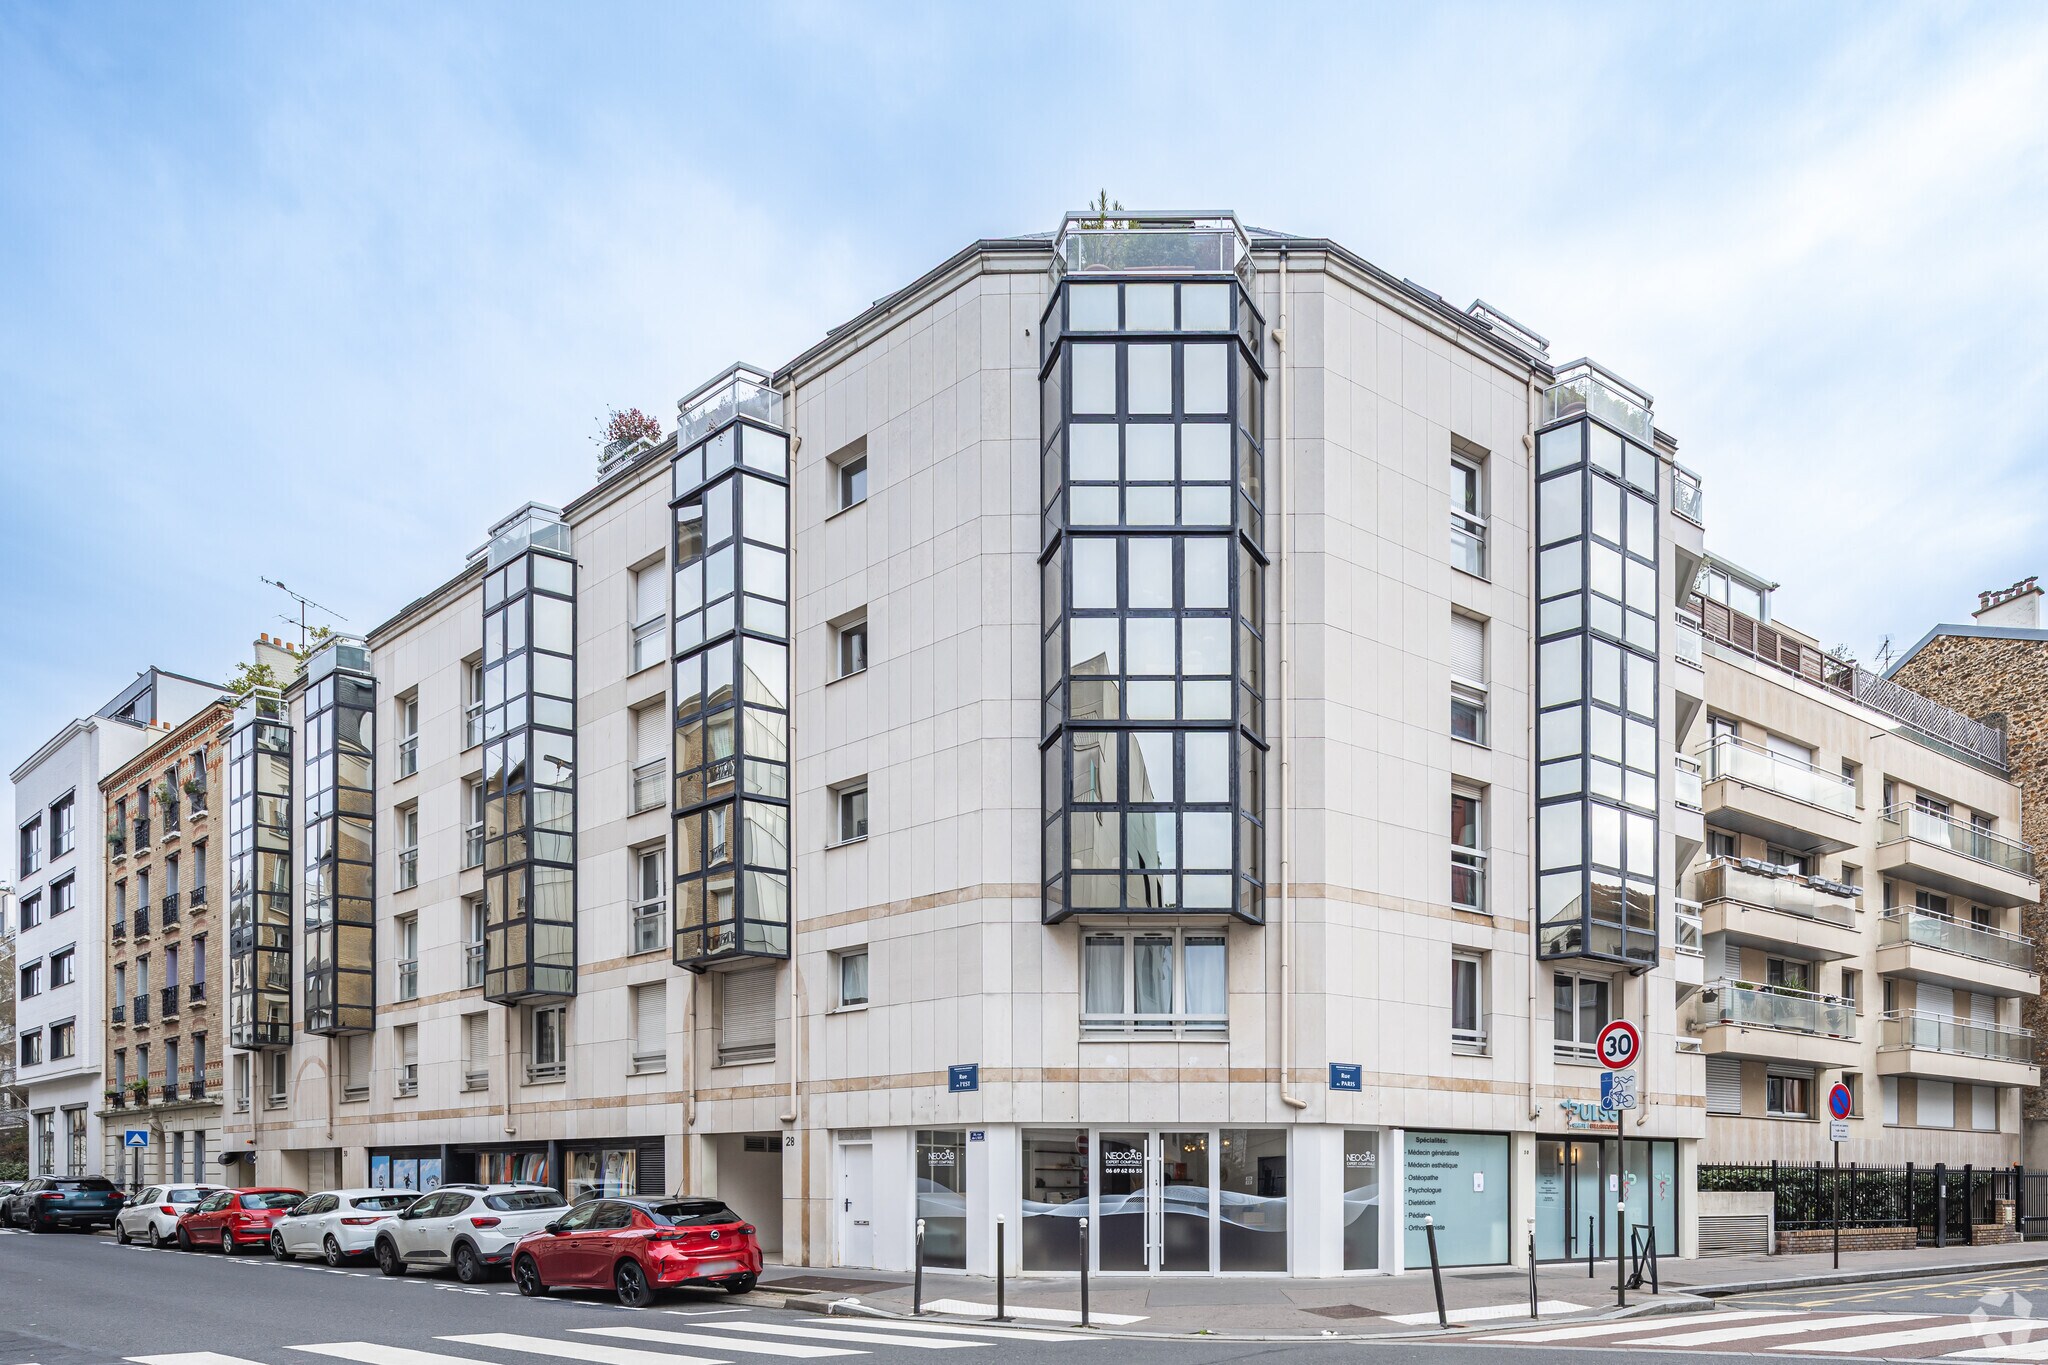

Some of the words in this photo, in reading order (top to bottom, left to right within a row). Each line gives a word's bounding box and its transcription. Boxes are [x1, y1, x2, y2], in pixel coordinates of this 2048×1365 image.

[1605, 1034, 1631, 1056] 30
[785, 1136, 795, 1146] 28
[1415, 1136, 1448, 1144] Spécialités:
[928, 1151, 955, 1160] NEOCAB
[1105, 1150, 1142, 1160] NEOCAB
[1346, 1153, 1376, 1162] NEOCAB
[1408, 1174, 1438, 1182] Ostéopathe
